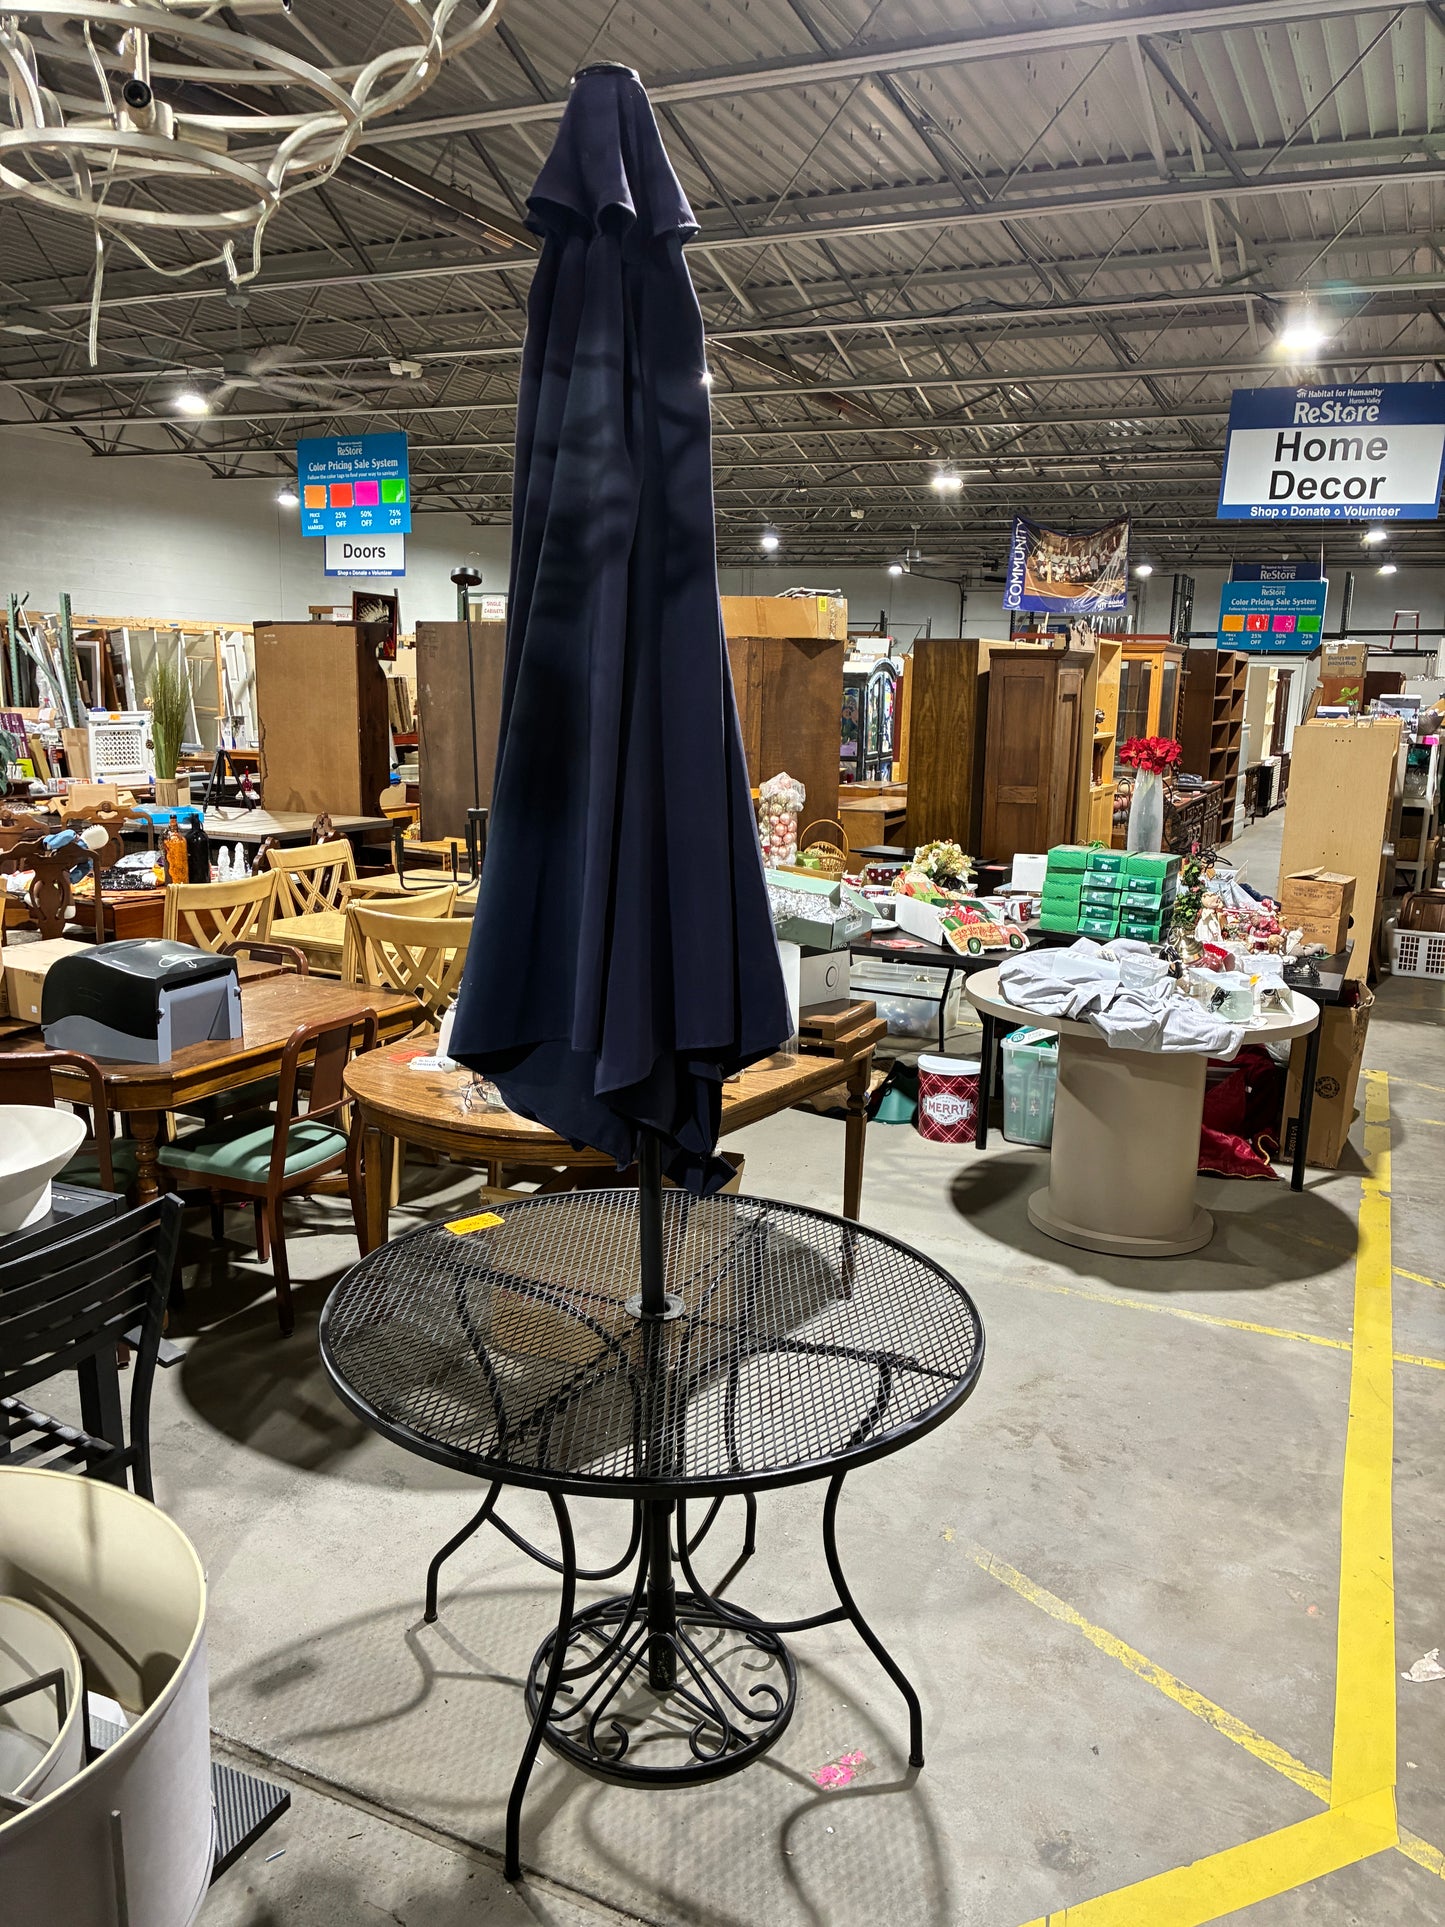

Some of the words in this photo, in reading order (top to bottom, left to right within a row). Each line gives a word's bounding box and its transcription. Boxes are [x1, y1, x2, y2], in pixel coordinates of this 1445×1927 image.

[1348, 388, 1382, 397] Humanity
[1294, 401, 1380, 424] ReStore
[338, 447, 362, 456] ReStore
[1274, 432, 1388, 462] Home
[309, 462, 326, 471] Color
[328, 461, 352, 471] Pricing
[354, 460, 369, 469] Sale
[372, 459, 398, 469] System
[1268, 470, 1386, 500] Decor
[1250, 506, 1279, 518] Shop
[1290, 507, 1330, 517] Donate
[1344, 506, 1400, 517] Volunteer
[344, 544, 386, 558] Doors
[1009, 518, 1026, 606] COMMUNITY
[1260, 570, 1296, 580] ReStore
[929, 1101, 965, 1115] MERRY
